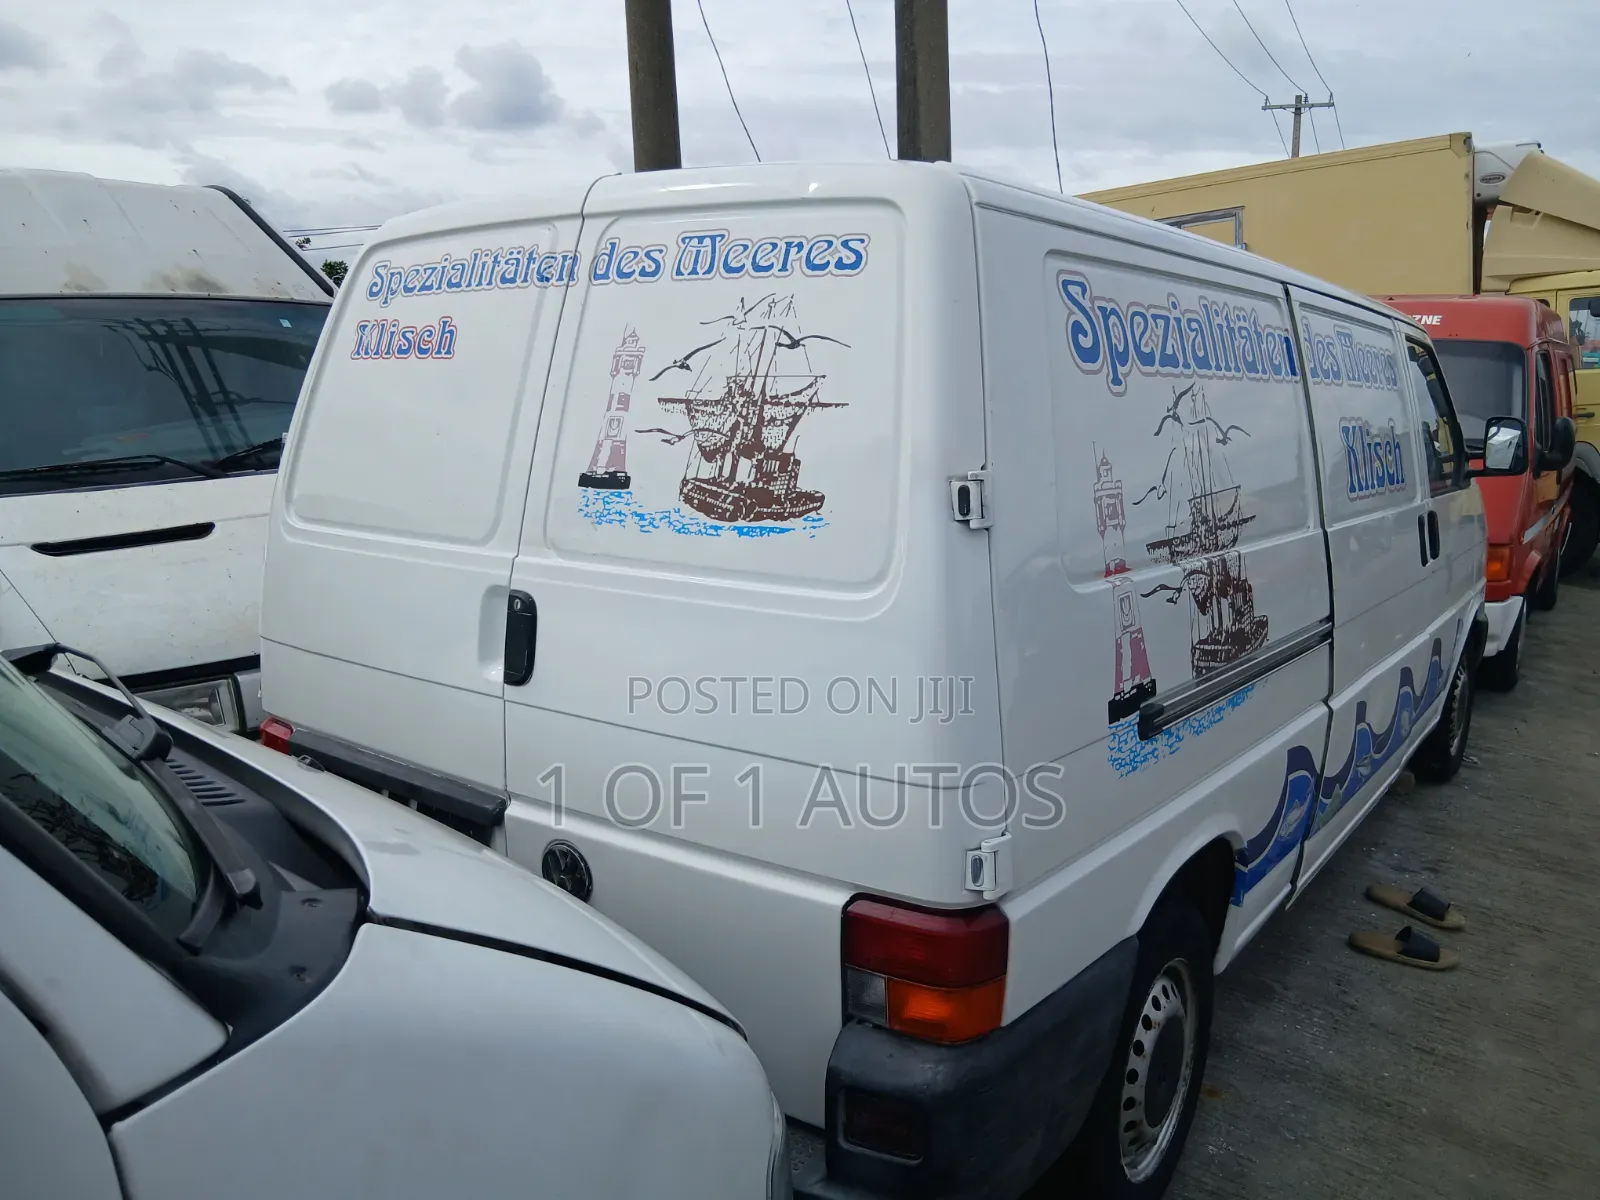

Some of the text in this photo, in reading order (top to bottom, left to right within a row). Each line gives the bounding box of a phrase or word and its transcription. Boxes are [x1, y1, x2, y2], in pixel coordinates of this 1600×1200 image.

[367, 230, 869, 306] Spezialitäten des Meeres
[350, 316, 457, 358] Klisch
[1058, 271, 1398, 395] Spezialitäten des Meeres
[1340, 417, 1406, 499] Klisch
